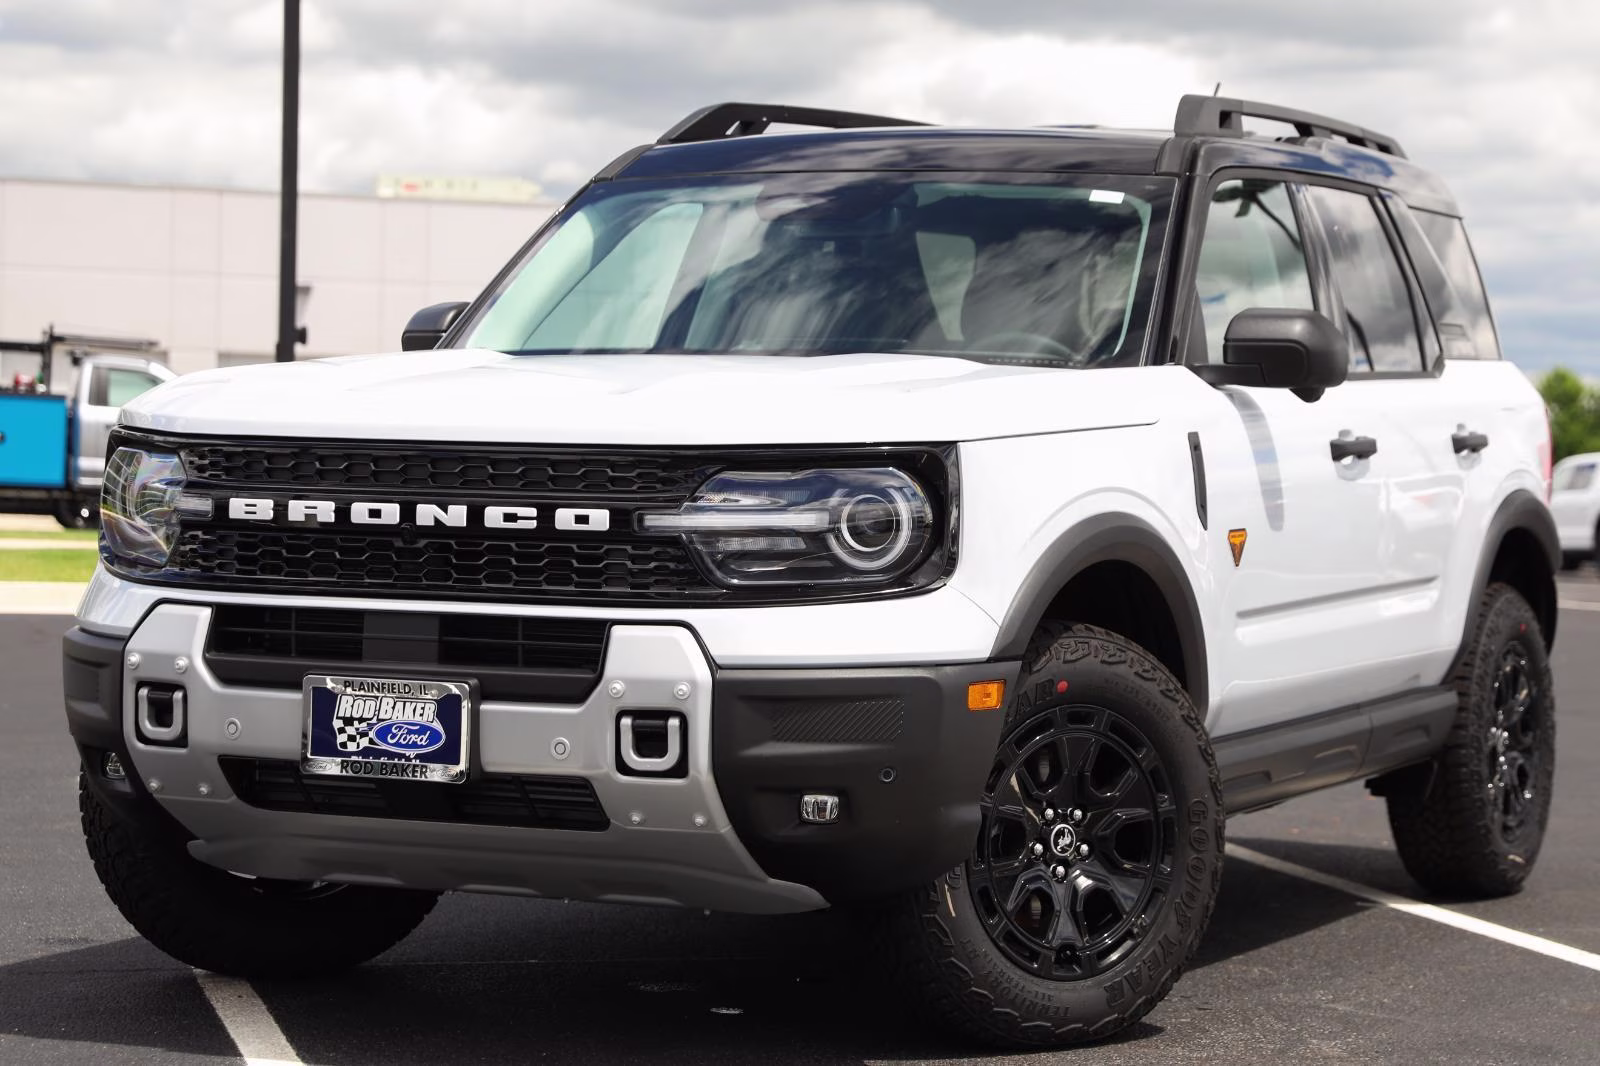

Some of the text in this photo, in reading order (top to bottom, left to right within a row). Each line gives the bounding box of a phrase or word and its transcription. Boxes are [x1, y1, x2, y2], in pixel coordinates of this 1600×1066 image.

[228, 497, 611, 532] BRONCO
[344, 680, 429, 696] PLAINFIELD, IL
[387, 724, 429, 746] Ford
[340, 760, 428, 779] ROD BAKER
